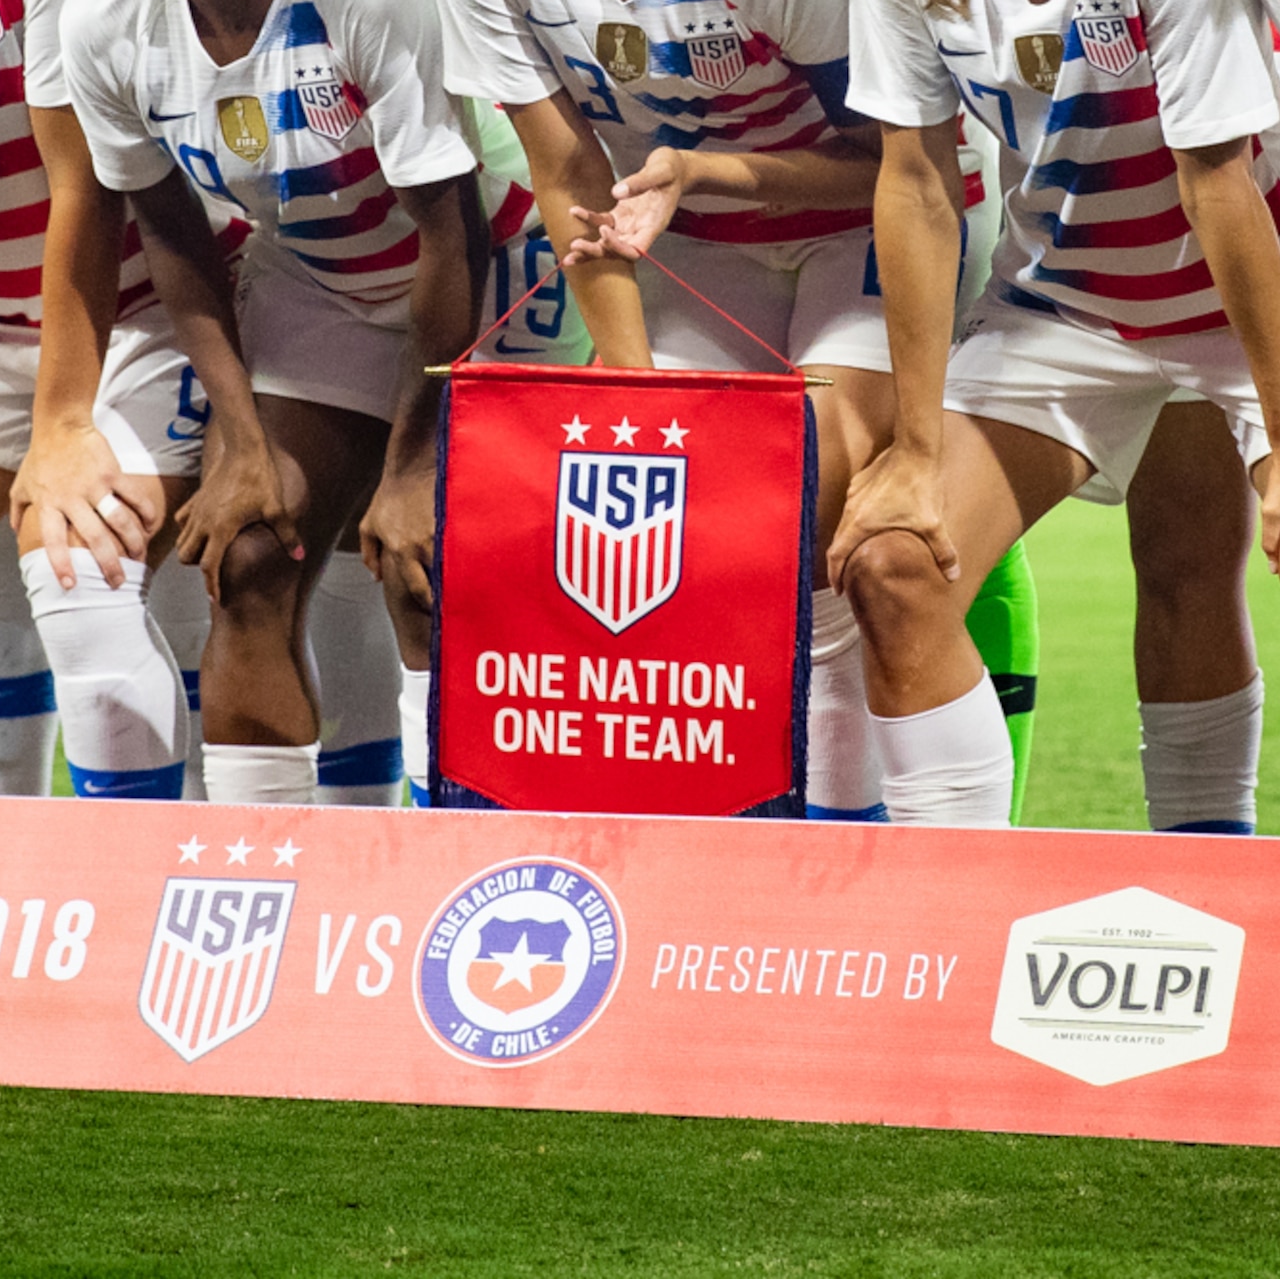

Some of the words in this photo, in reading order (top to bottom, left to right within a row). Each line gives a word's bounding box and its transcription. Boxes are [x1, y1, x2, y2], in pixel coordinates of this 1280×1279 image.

[690, 33, 737, 59] USA
[1080, 20, 1125, 43] USA
[302, 84, 344, 108] USA
[567, 462, 677, 530] USA
[475, 651, 565, 699] ONE
[578, 656, 756, 710] NATION.
[493, 708, 583, 755] ONE
[595, 713, 736, 765] TEAM.
[166, 888, 285, 957] USA
[427, 867, 537, 961] FEDERACION
[547, 871, 578, 896] DE
[574, 897, 616, 965] FUTBOL
[1128, 928, 1152, 939] 1902
[315, 914, 401, 997] VS
[651, 943, 888, 999] PRESENTED
[903, 954, 959, 1002] BY
[1025, 951, 1213, 1015] VOLPI
[451, 1023, 483, 1053] DE
[490, 1024, 552, 1056] CHILE
[1052, 1032, 1111, 1045] AMERICAN
[1114, 1034, 1166, 1046] CRAFTED
